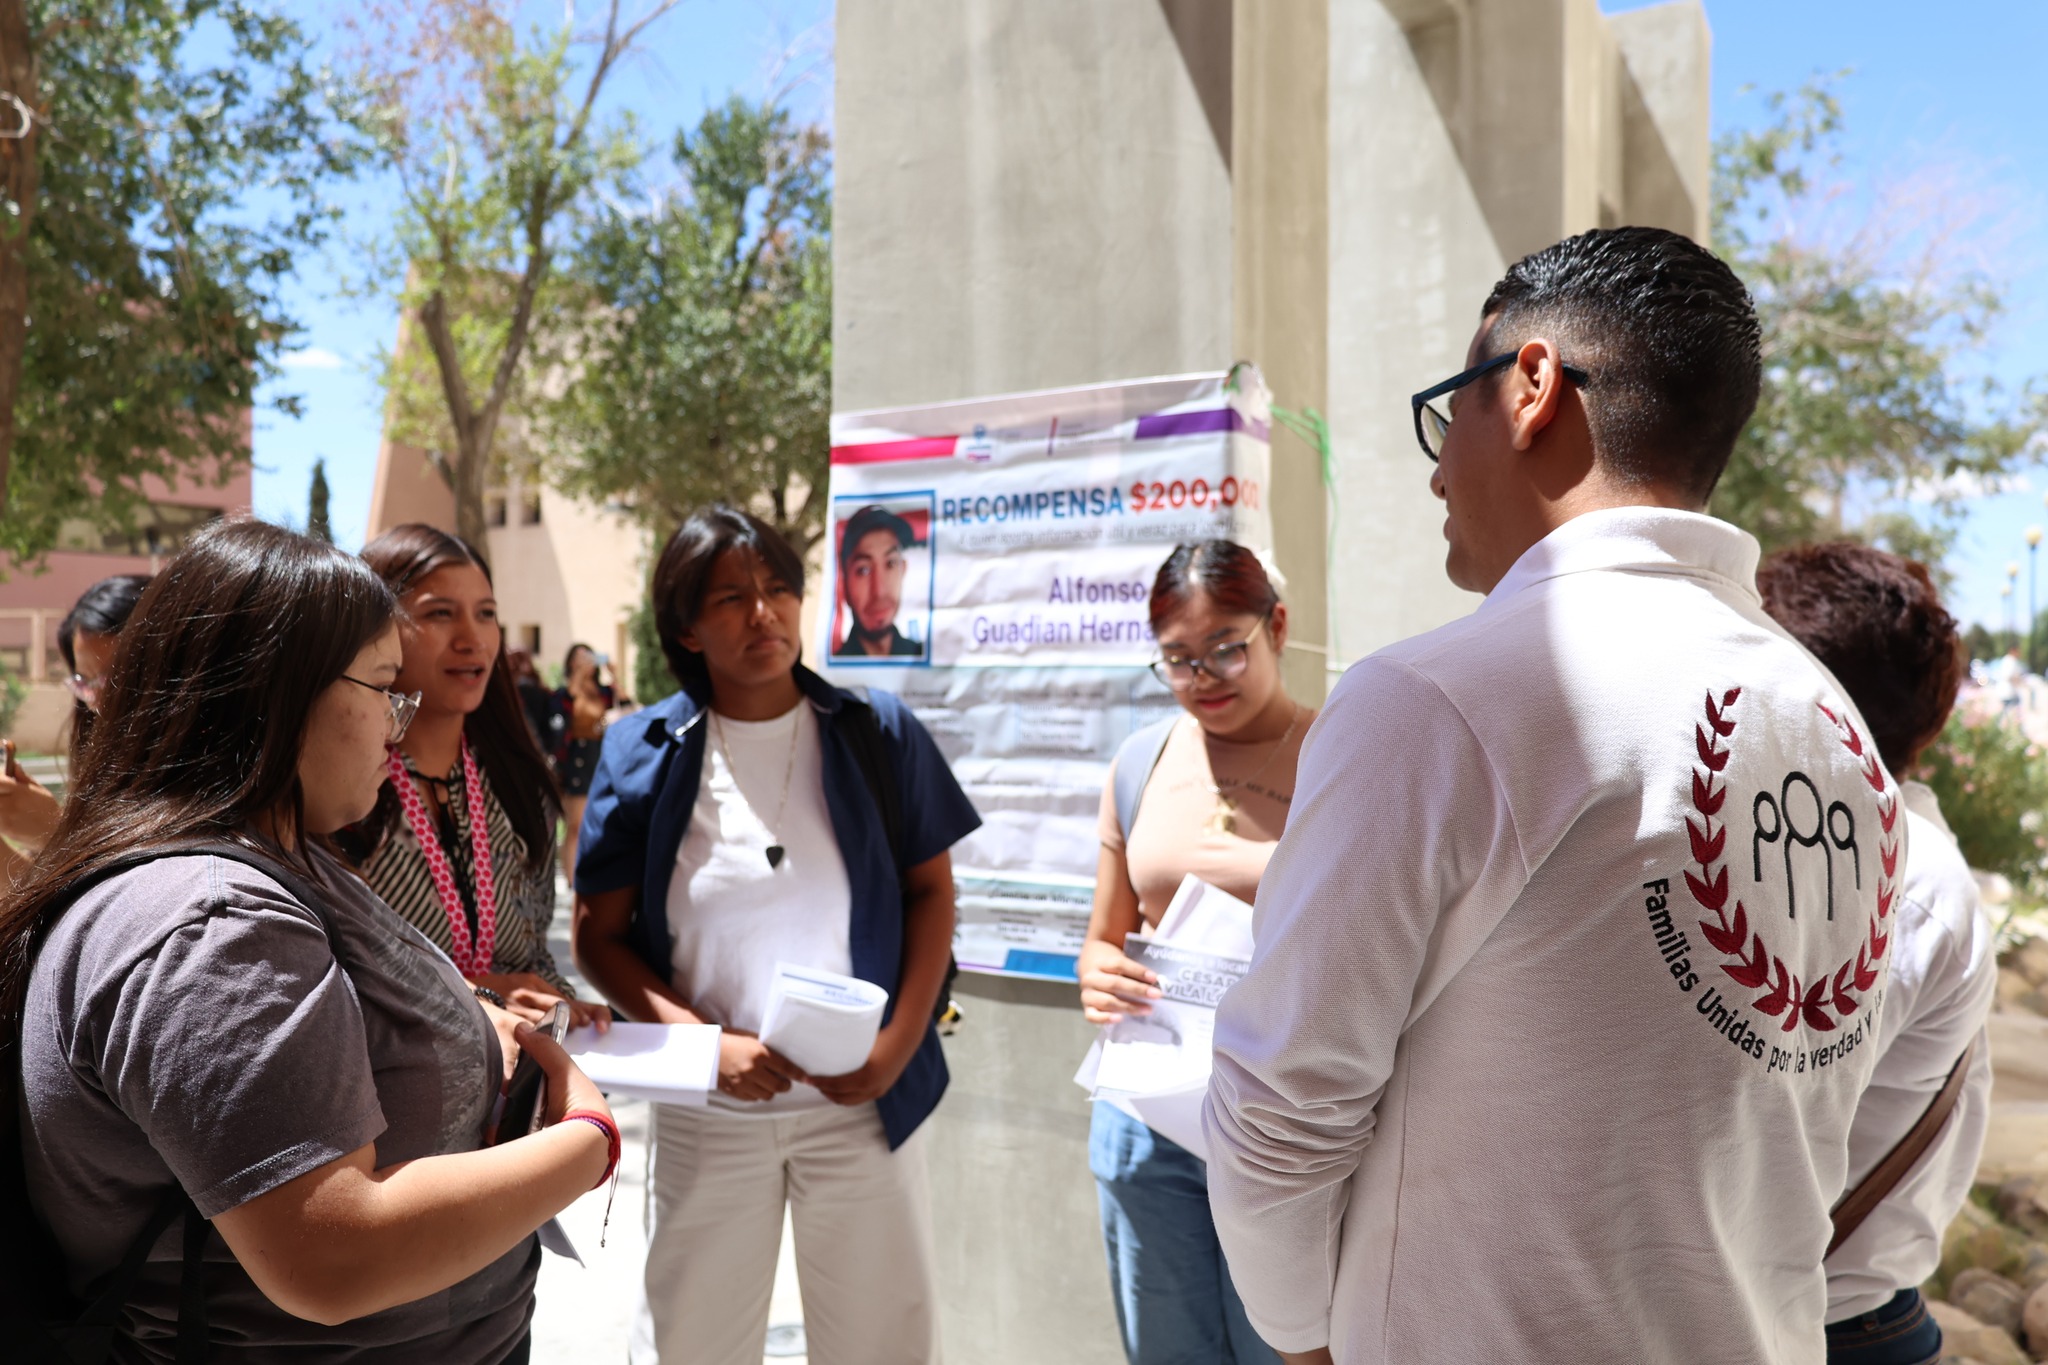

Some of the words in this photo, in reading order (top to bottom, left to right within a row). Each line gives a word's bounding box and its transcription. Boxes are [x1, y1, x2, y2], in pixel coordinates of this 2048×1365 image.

[943, 487, 1124, 526] RECOMPENSA
[1049, 577, 1147, 604] Alfonso
[973, 614, 1071, 644] Guadian
[1080, 614, 1157, 642] Herna
[1216, 958, 1249, 974] locali
[1643, 877, 1700, 992] Familias
[1696, 987, 1766, 1060] Unidas
[1767, 1045, 1791, 1074] por
[1794, 1046, 1805, 1073] la
[1810, 1020, 1862, 1071] verdad
[1161, 981, 1201, 1000] VILA
